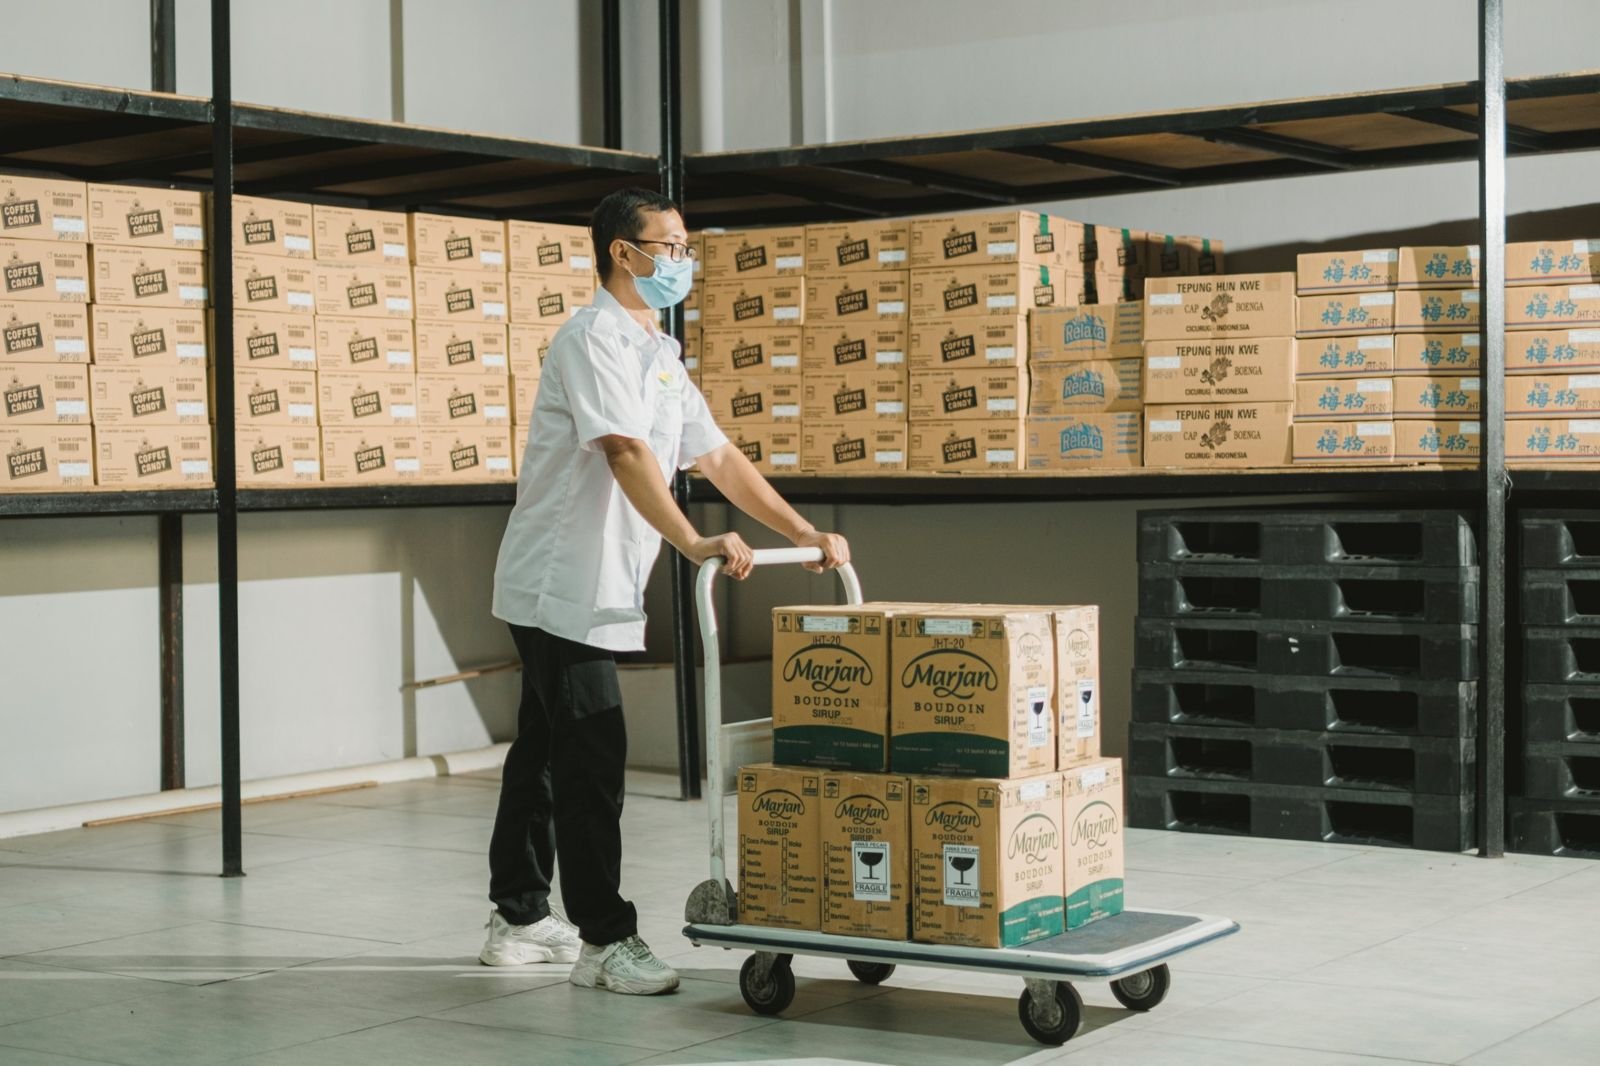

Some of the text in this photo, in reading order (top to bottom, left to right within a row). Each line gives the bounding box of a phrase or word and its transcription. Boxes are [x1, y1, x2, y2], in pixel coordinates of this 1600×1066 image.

[4, 202, 35, 216] COFFEE
[8, 214, 35, 226] CANDY
[129, 212, 158, 225] COFFEE
[133, 224, 157, 235] CANDY
[244, 222, 271, 233] COFFEE
[247, 232, 270, 242] CANDY
[945, 234, 972, 248] COFFEE
[839, 242, 864, 255] COFFEE
[948, 244, 971, 256] CANDY
[842, 252, 863, 263] CANDY
[1424, 259, 1476, 278] 梅粉
[1530, 255, 1583, 273] 梅粉
[7, 264, 38, 278] COFFEE
[1323, 264, 1372, 283] 梅粉
[11, 276, 37, 289] CANDY
[135, 272, 163, 285] COFFEE
[247, 278, 273, 290] COFFEE
[139, 283, 162, 294] CANDY
[1176, 281, 1260, 293] TEPUNG HUN KWE
[250, 289, 272, 299] CANDY
[838, 292, 863, 305] COFFEE
[946, 287, 972, 300] COFFEE
[841, 302, 862, 313] CANDY
[948, 296, 971, 308] CANDY
[1184, 302, 1263, 313] CAP BOENGA
[1421, 303, 1470, 322] 梅粉
[1525, 299, 1578, 318] 梅粉
[1322, 307, 1369, 325] 梅粉
[6, 326, 37, 339] COFFEE
[133, 332, 161, 345] COFFEE
[1064, 324, 1105, 341] Relaxa
[10, 337, 36, 350] CANDY
[137, 342, 160, 354] CANDY
[248, 336, 274, 348] COFFEE
[350, 340, 374, 352] COFFEE
[836, 342, 861, 354] COFFEE
[943, 338, 970, 351] COFFEE
[251, 346, 274, 357] CANDY
[353, 350, 374, 360] CANDY
[734, 347, 758, 358] COFFEE
[946, 348, 969, 359] CANDY
[1176, 345, 1259, 356] TEPUNG HUN KWE
[1420, 347, 1470, 365] 梅粉
[1525, 345, 1577, 363] 梅粉
[839, 352, 860, 363] CANDY
[1320, 350, 1367, 368] 梅粉
[1184, 368, 1198, 377] CAP
[1235, 366, 1263, 375] BOENGA
[1064, 379, 1103, 396] Relaxa
[7, 388, 38, 402] COFFEE
[133, 390, 161, 403] COFFEE
[250, 392, 275, 404] COFFEE
[353, 395, 377, 406] COFFEE
[734, 395, 758, 407] COFFEE
[836, 392, 861, 404] COFFEE
[945, 389, 972, 402] COFFEE
[1419, 391, 1469, 408] 梅粉
[1526, 389, 1579, 408] 梅粉
[11, 400, 37, 412] CANDY
[136, 401, 160, 413] CANDY
[253, 402, 274, 413] CANDY
[839, 401, 860, 412] CANDY
[948, 399, 971, 410] CANDY
[1318, 392, 1367, 411] 梅粉
[356, 404, 376, 414] CANDY
[1176, 409, 1257, 420] TEPUNG HUN KWE
[1183, 430, 1261, 440] CAP BOENGA
[835, 441, 860, 453] COFFEE
[944, 440, 971, 452] COFFEE
[1062, 434, 1101, 449] Relaxa
[1316, 435, 1365, 453] 梅粉
[1419, 434, 1469, 452] 梅粉
[1526, 434, 1579, 453] 梅粉
[10, 451, 42, 465] COFFEE
[138, 450, 166, 464] COFFEE
[253, 450, 279, 462] COFFEE
[356, 450, 381, 461] COFFEE
[838, 450, 860, 461] CANDY
[947, 450, 970, 461] CANDY
[14, 462, 40, 475] CANDY
[141, 460, 165, 473] CANDY
[256, 459, 278, 470] CANDY
[359, 459, 380, 470] CANDY
[932, 638, 965, 648] JHT-20
[783, 657, 872, 693] Marjan
[902, 664, 998, 700] Marjan
[794, 696, 859, 708] BOUDOIN
[914, 702, 984, 713] BOUDOIN
[812, 709, 841, 718] SIRUP
[934, 715, 965, 725] SIRUP
[752, 798, 805, 820] Marjan
[835, 804, 889, 825] Marjan
[759, 820, 797, 828] BOUDOIN
[925, 810, 981, 832] Marjan
[1071, 814, 1118, 850] Marjan
[1008, 826, 1059, 864] Marjan
[1078, 849, 1112, 868] BOUDOIN
[1015, 865, 1053, 882] BOUDOIN
[946, 888, 979, 897] FRAGILE
